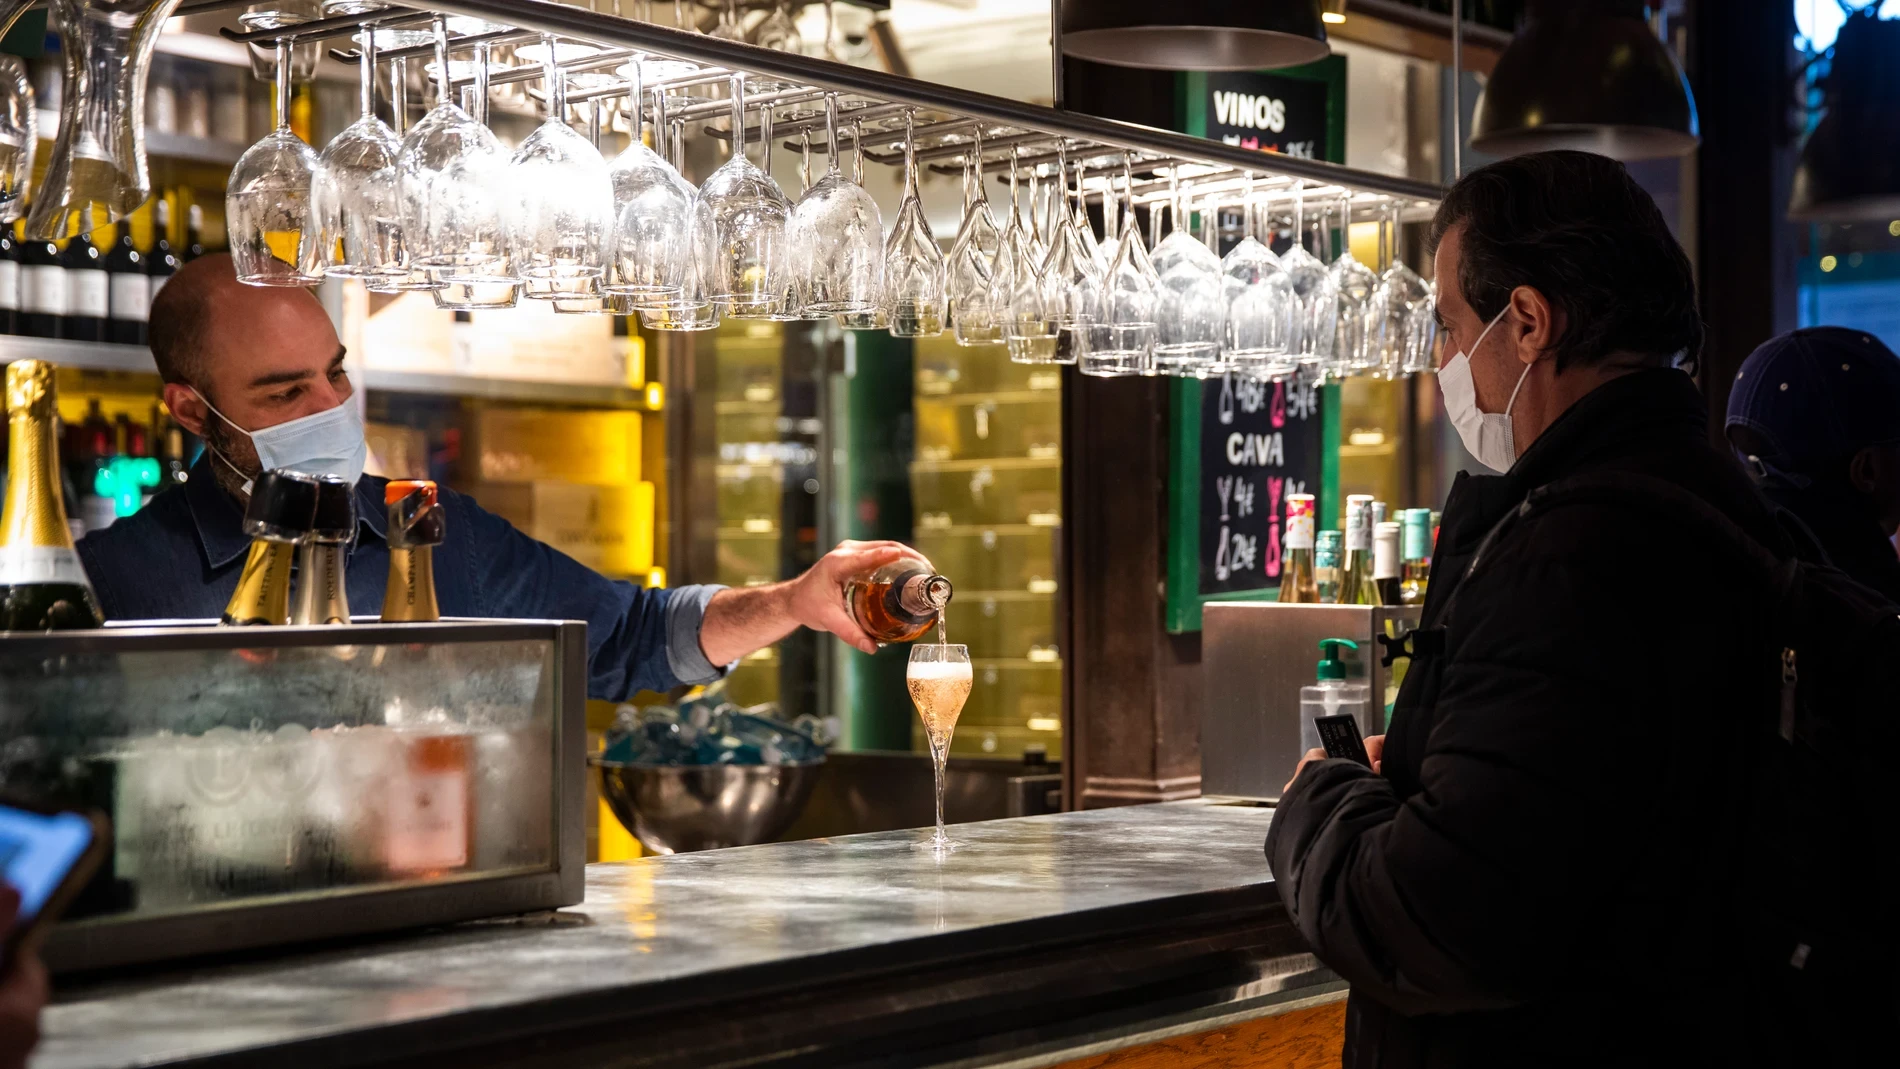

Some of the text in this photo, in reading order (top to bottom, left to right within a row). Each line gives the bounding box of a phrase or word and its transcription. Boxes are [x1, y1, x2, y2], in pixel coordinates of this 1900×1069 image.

[1213, 90, 1286, 133] VINOS
[1226, 431, 1284, 467] CAVA
[1233, 476, 1255, 518] 4€
[407, 547, 416, 606] CHAMPAGN
